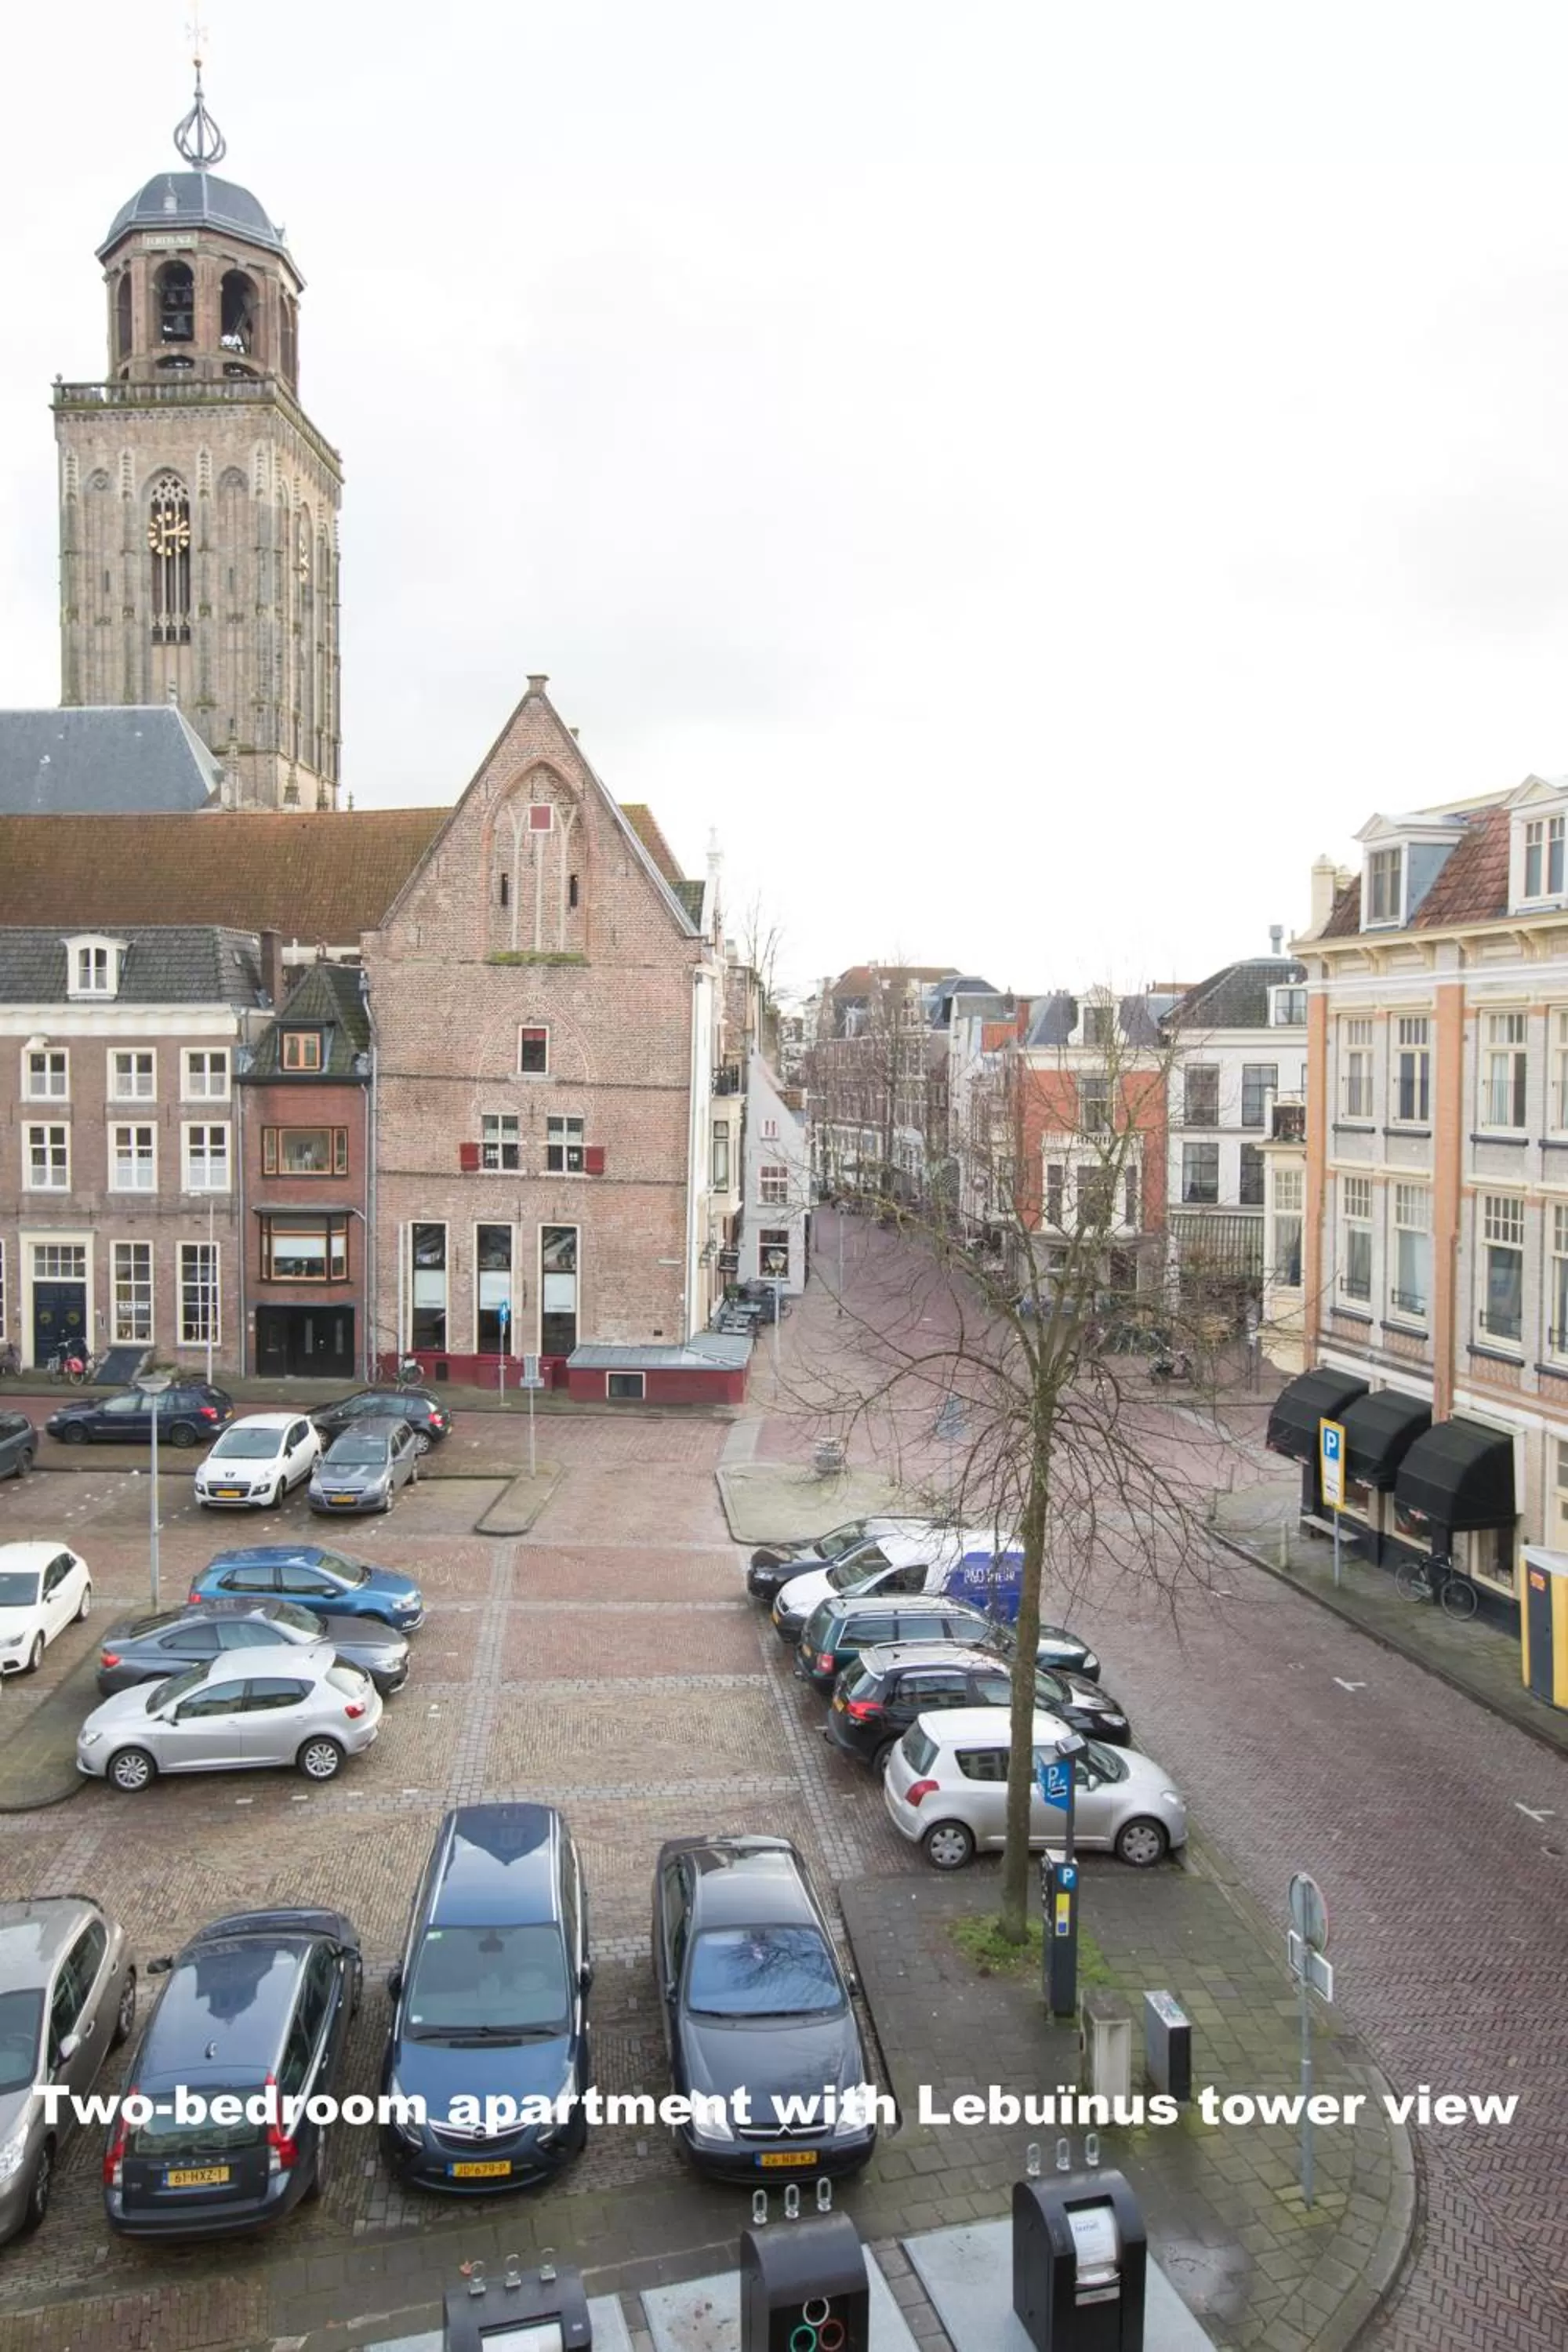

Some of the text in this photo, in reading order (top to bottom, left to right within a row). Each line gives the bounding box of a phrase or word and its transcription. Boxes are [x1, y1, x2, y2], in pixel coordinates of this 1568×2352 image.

[1326, 1430, 1337, 1456] P
[1047, 1767, 1059, 1788] P
[1062, 1867, 1074, 1886] P
